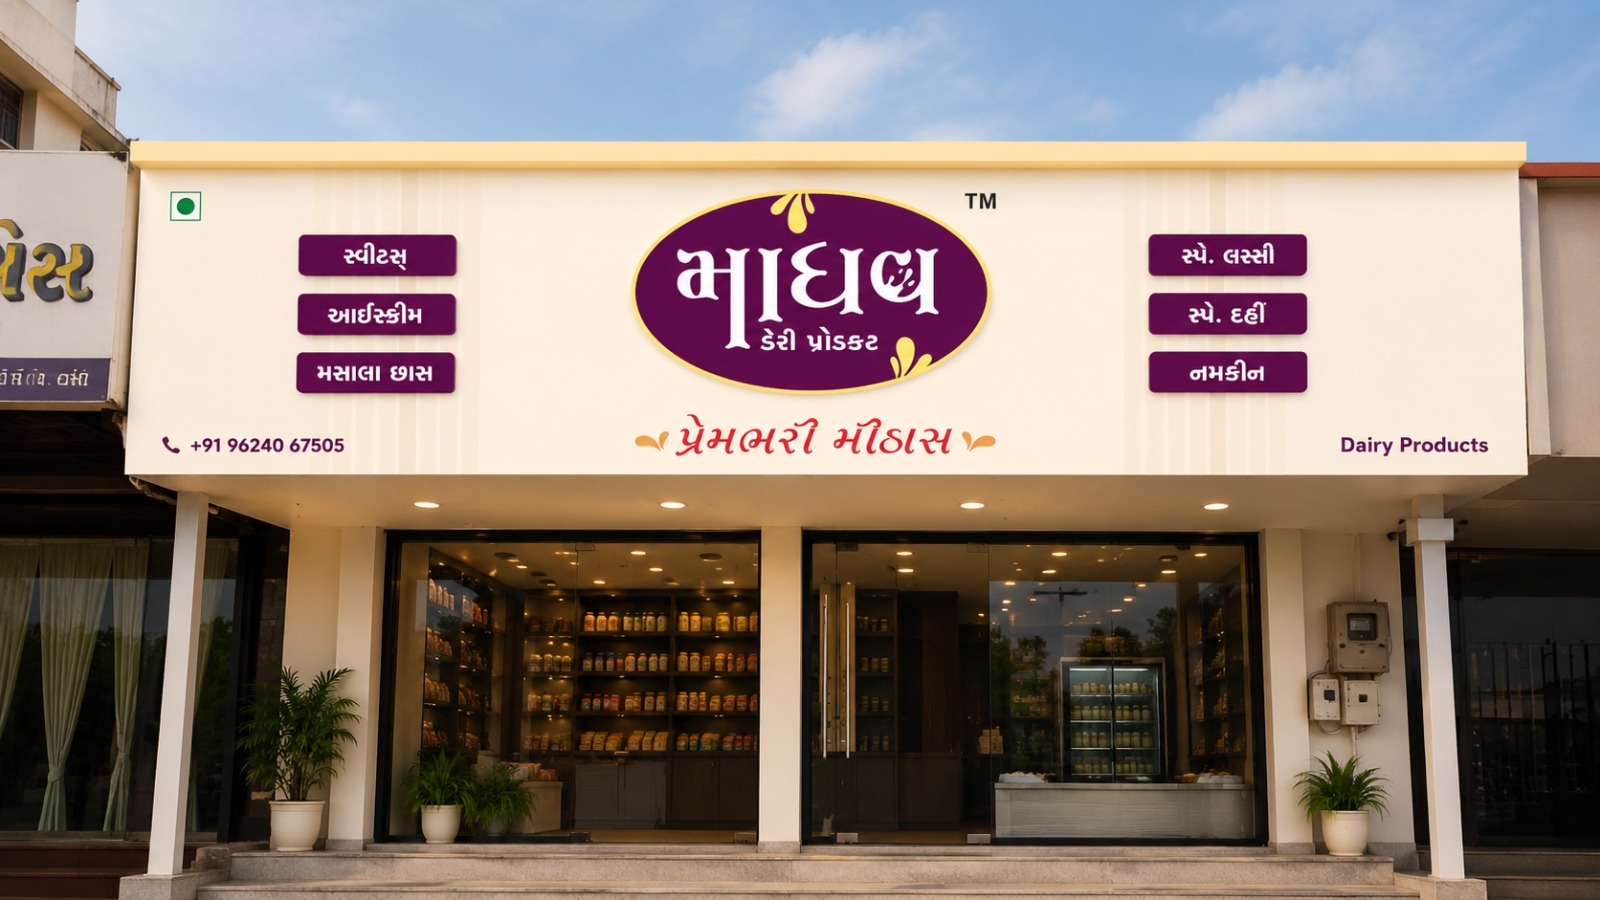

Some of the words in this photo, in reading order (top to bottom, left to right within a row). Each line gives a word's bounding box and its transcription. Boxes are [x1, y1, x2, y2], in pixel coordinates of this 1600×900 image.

[964, 192, 997, 210] TM
[343, 242, 407, 271] સ્વીટસ્
[1181, 242, 1214, 265] સ્પે.
[1223, 242, 1275, 265] લસ્સી
[327, 301, 422, 324] આઈસ્ક્રીમ
[1188, 301, 1222, 324] સ્પે.
[1230, 301, 1267, 325] દહીં
[760, 328, 796, 351] ડેરી
[806, 326, 879, 353] પ્રોડકટ
[317, 365, 381, 382] મસાલા
[389, 365, 433, 382] છાસ
[1189, 359, 1265, 382] નમકીન
[190, 437, 221, 453] +91
[227, 437, 284, 453] 96240
[289, 437, 345, 453] 67505
[675, 414, 819, 457] પ્રેમભરી
[833, 417, 952, 455] મીઠાસ
[1341, 436, 1394, 457] Dairy
[1400, 436, 1489, 453] Products
